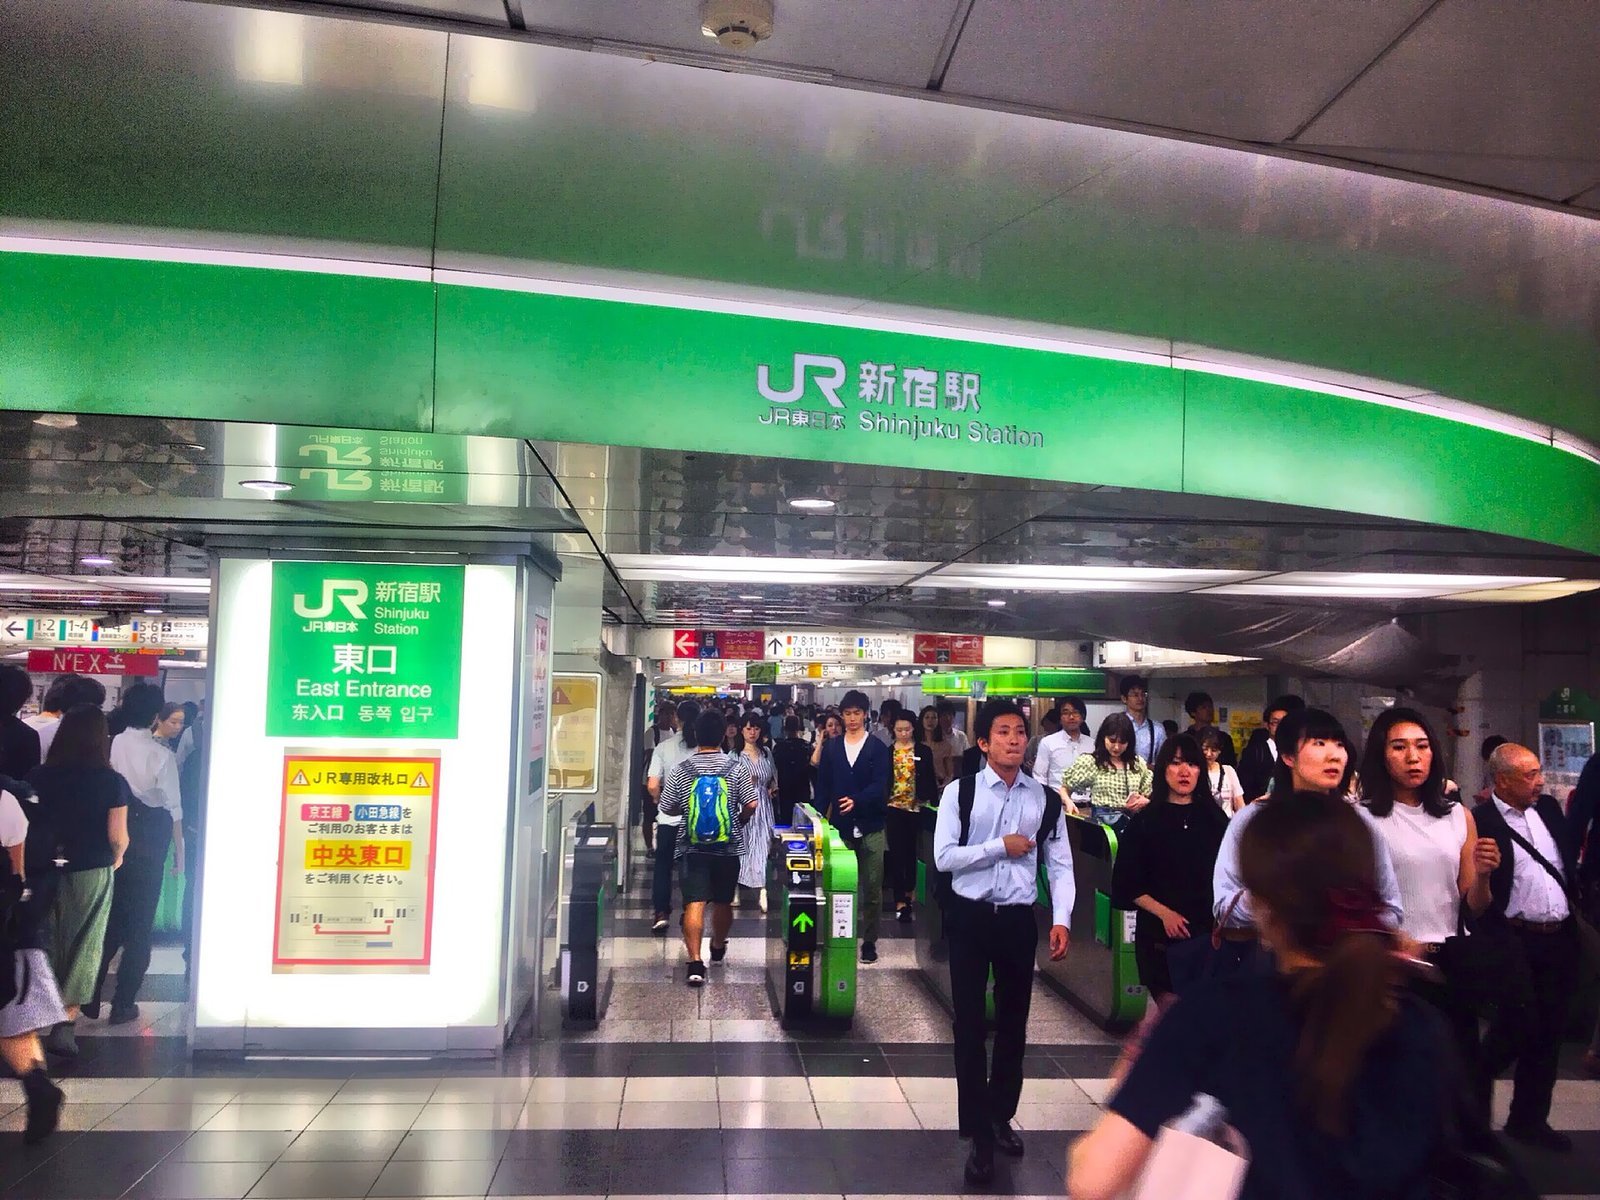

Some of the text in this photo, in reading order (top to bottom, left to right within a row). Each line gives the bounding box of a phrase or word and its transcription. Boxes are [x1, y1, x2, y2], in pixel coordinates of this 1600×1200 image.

[757, 352, 847, 408] JR
[858, 361, 981, 413] 新宿駅
[758, 406, 846, 430] JR東日本
[859, 410, 1044, 448] Shinjuku Station
[293, 579, 369, 619] JR
[375, 581, 441, 603] 新宿駅
[374, 606, 429, 621] Shinjuku
[303, 621, 359, 633] JR東日本
[374, 622, 419, 635] Station
[332, 642, 397, 675] 東口
[296, 678, 432, 698] East Entrance
[291, 704, 344, 721] 东入口
[358, 706, 434, 722] 동쪽 입구
[313, 772, 408, 785] JR専用改札口
[307, 823, 413, 835] ご利用のお客さまは
[312, 844, 404, 866] 中央東口
[304, 872, 404, 885] をご利用ください。
